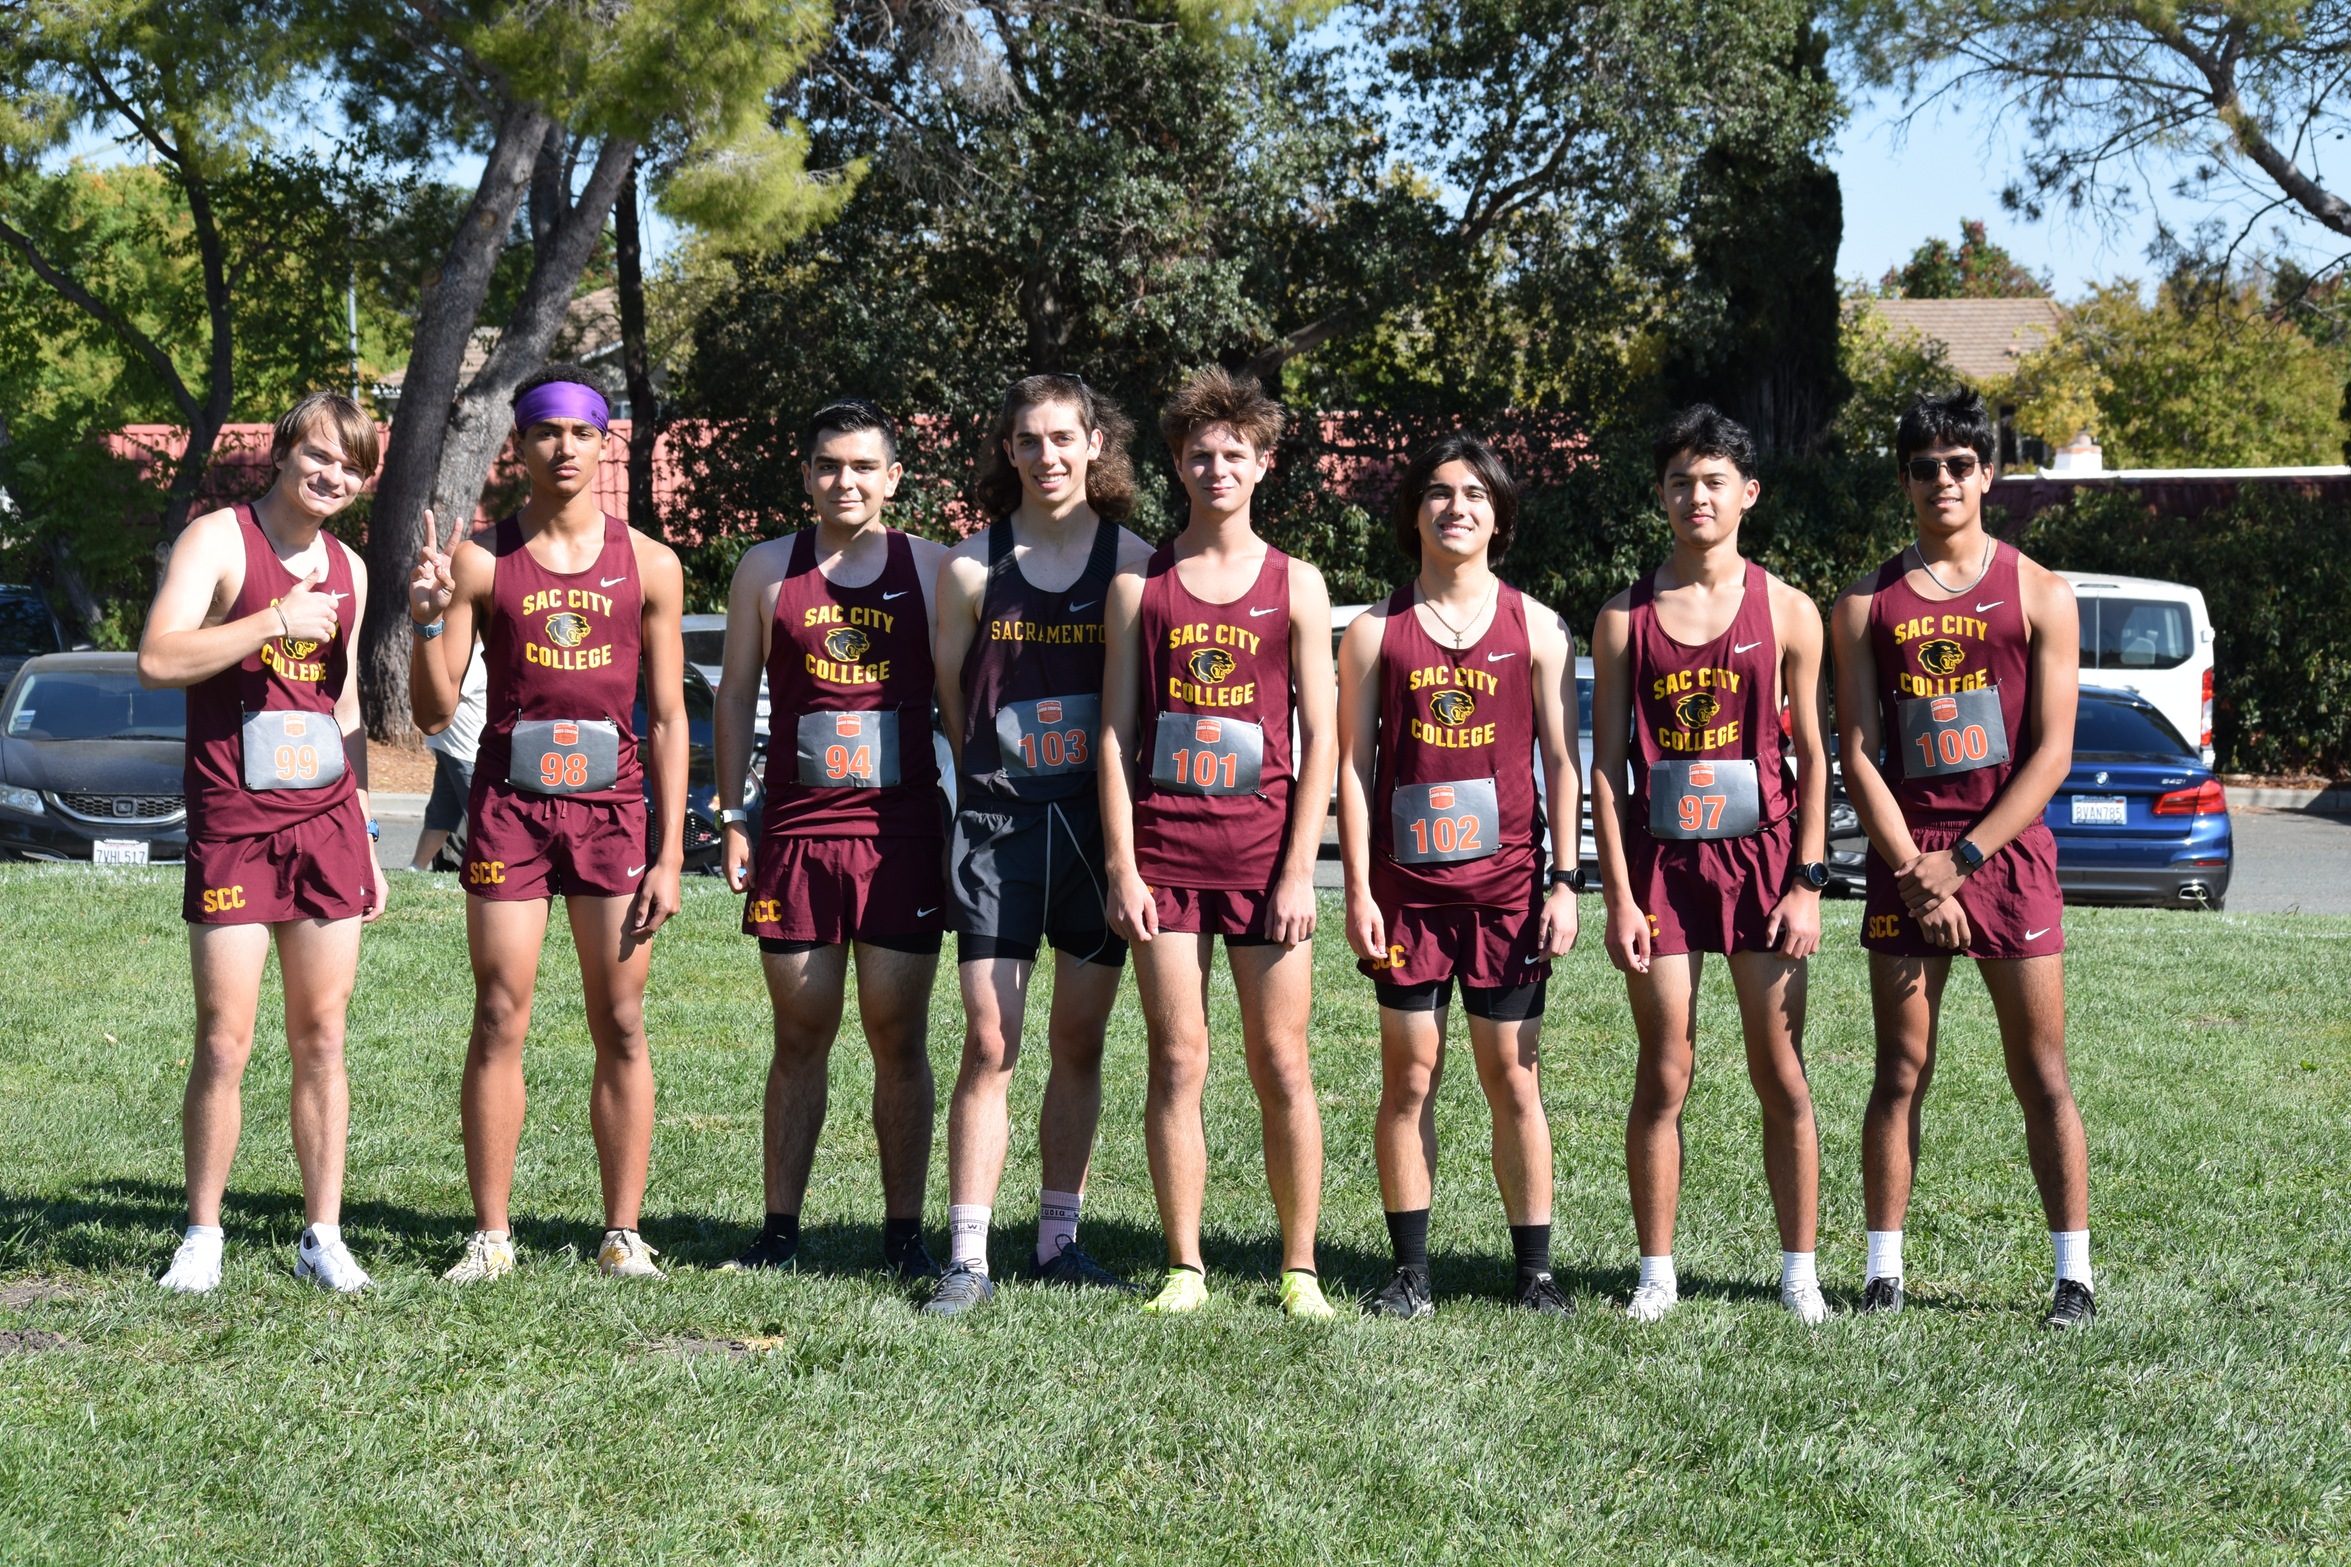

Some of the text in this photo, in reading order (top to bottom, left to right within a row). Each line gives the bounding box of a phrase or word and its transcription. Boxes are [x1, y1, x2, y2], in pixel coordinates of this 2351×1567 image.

[523, 589, 613, 617] SAC CITY
[804, 604, 894, 633] SAC CITY
[1169, 623, 1261, 655] SAC CITY
[1894, 614, 1987, 645] SAC CITY
[261, 643, 326, 682] COLLEGE
[526, 642, 612, 670] COLLEGE
[805, 653, 890, 685] COLLEGE
[1169, 677, 1255, 707] COLLEGE
[1409, 665, 1498, 697] SAC CITY
[1653, 667, 1740, 700] SAC CITY
[1900, 668, 1987, 697] COLLEGE
[1018, 729, 1088, 768] 103
[1411, 717, 1495, 748] COLLEGE
[1658, 720, 1739, 752] COLLEGE
[1916, 725, 1988, 767] 100
[274, 744, 319, 780] 99
[540, 752, 588, 786] 98
[826, 745, 873, 780] 94
[1172, 749, 1238, 788] 101
[1678, 795, 1726, 831] 97
[2076, 806, 2122, 820] 8VAN785
[1409, 815, 1481, 854] 102
[96, 849, 145, 865] 7VHL517
[470, 861, 506, 884] SCC
[203, 885, 246, 913] SCC
[747, 899, 782, 923] SCC
[1869, 914, 1899, 938] SCC
